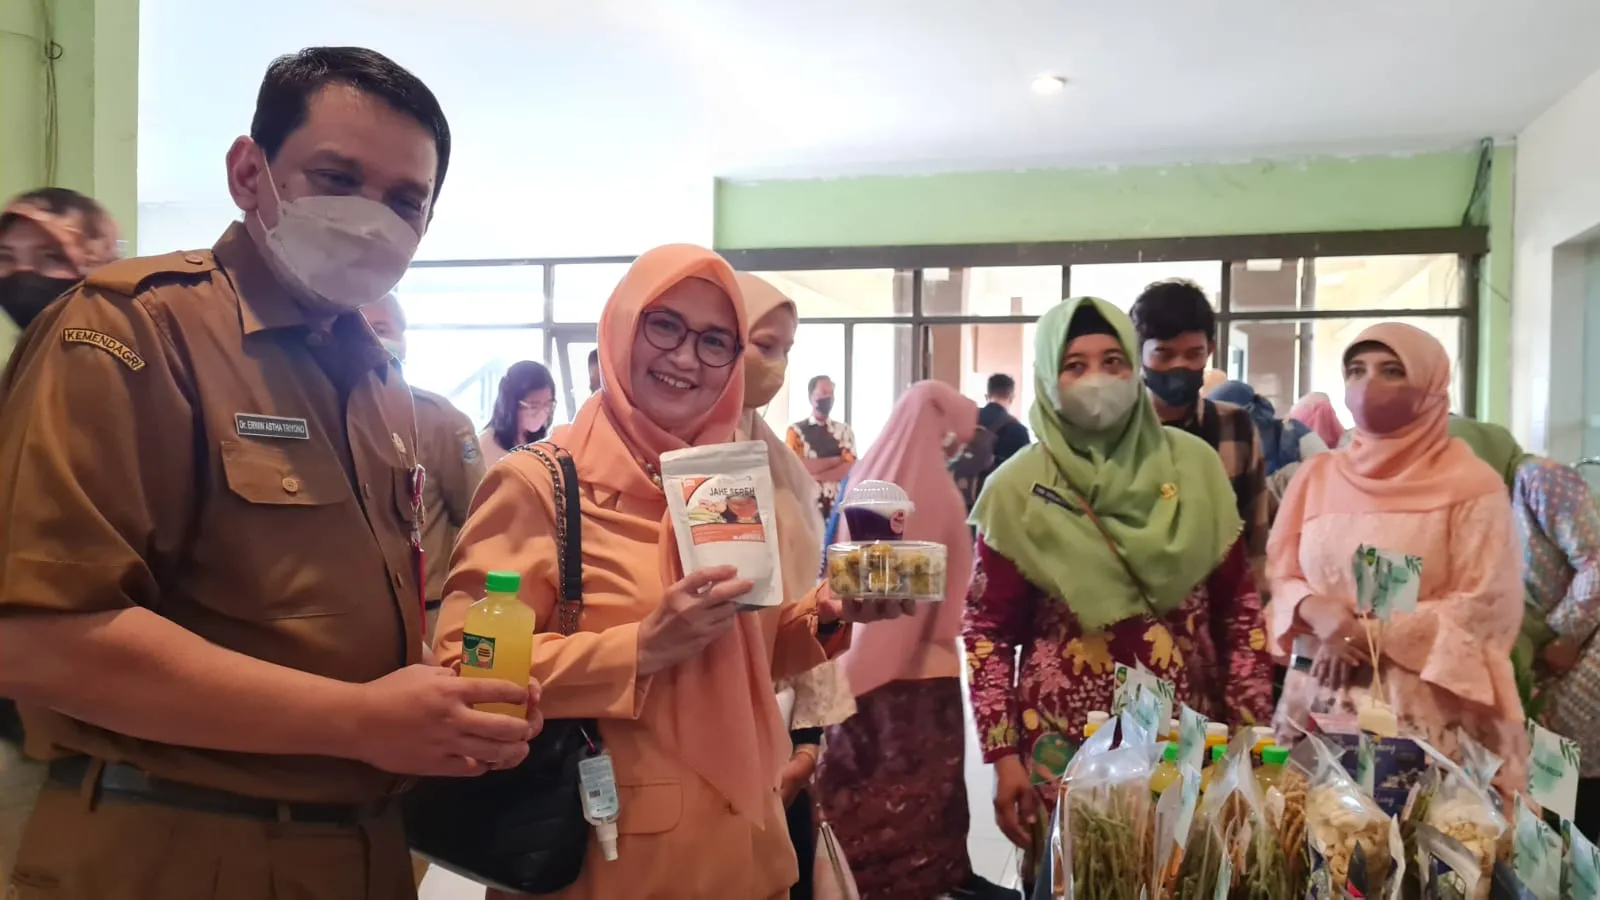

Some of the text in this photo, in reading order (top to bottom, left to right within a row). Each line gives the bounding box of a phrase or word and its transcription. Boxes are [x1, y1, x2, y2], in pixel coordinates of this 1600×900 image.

[66, 329, 144, 370] KEMENDAGRI
[265, 421, 283, 432] ASTHA
[709, 486, 755, 497] JAHE SEREH
